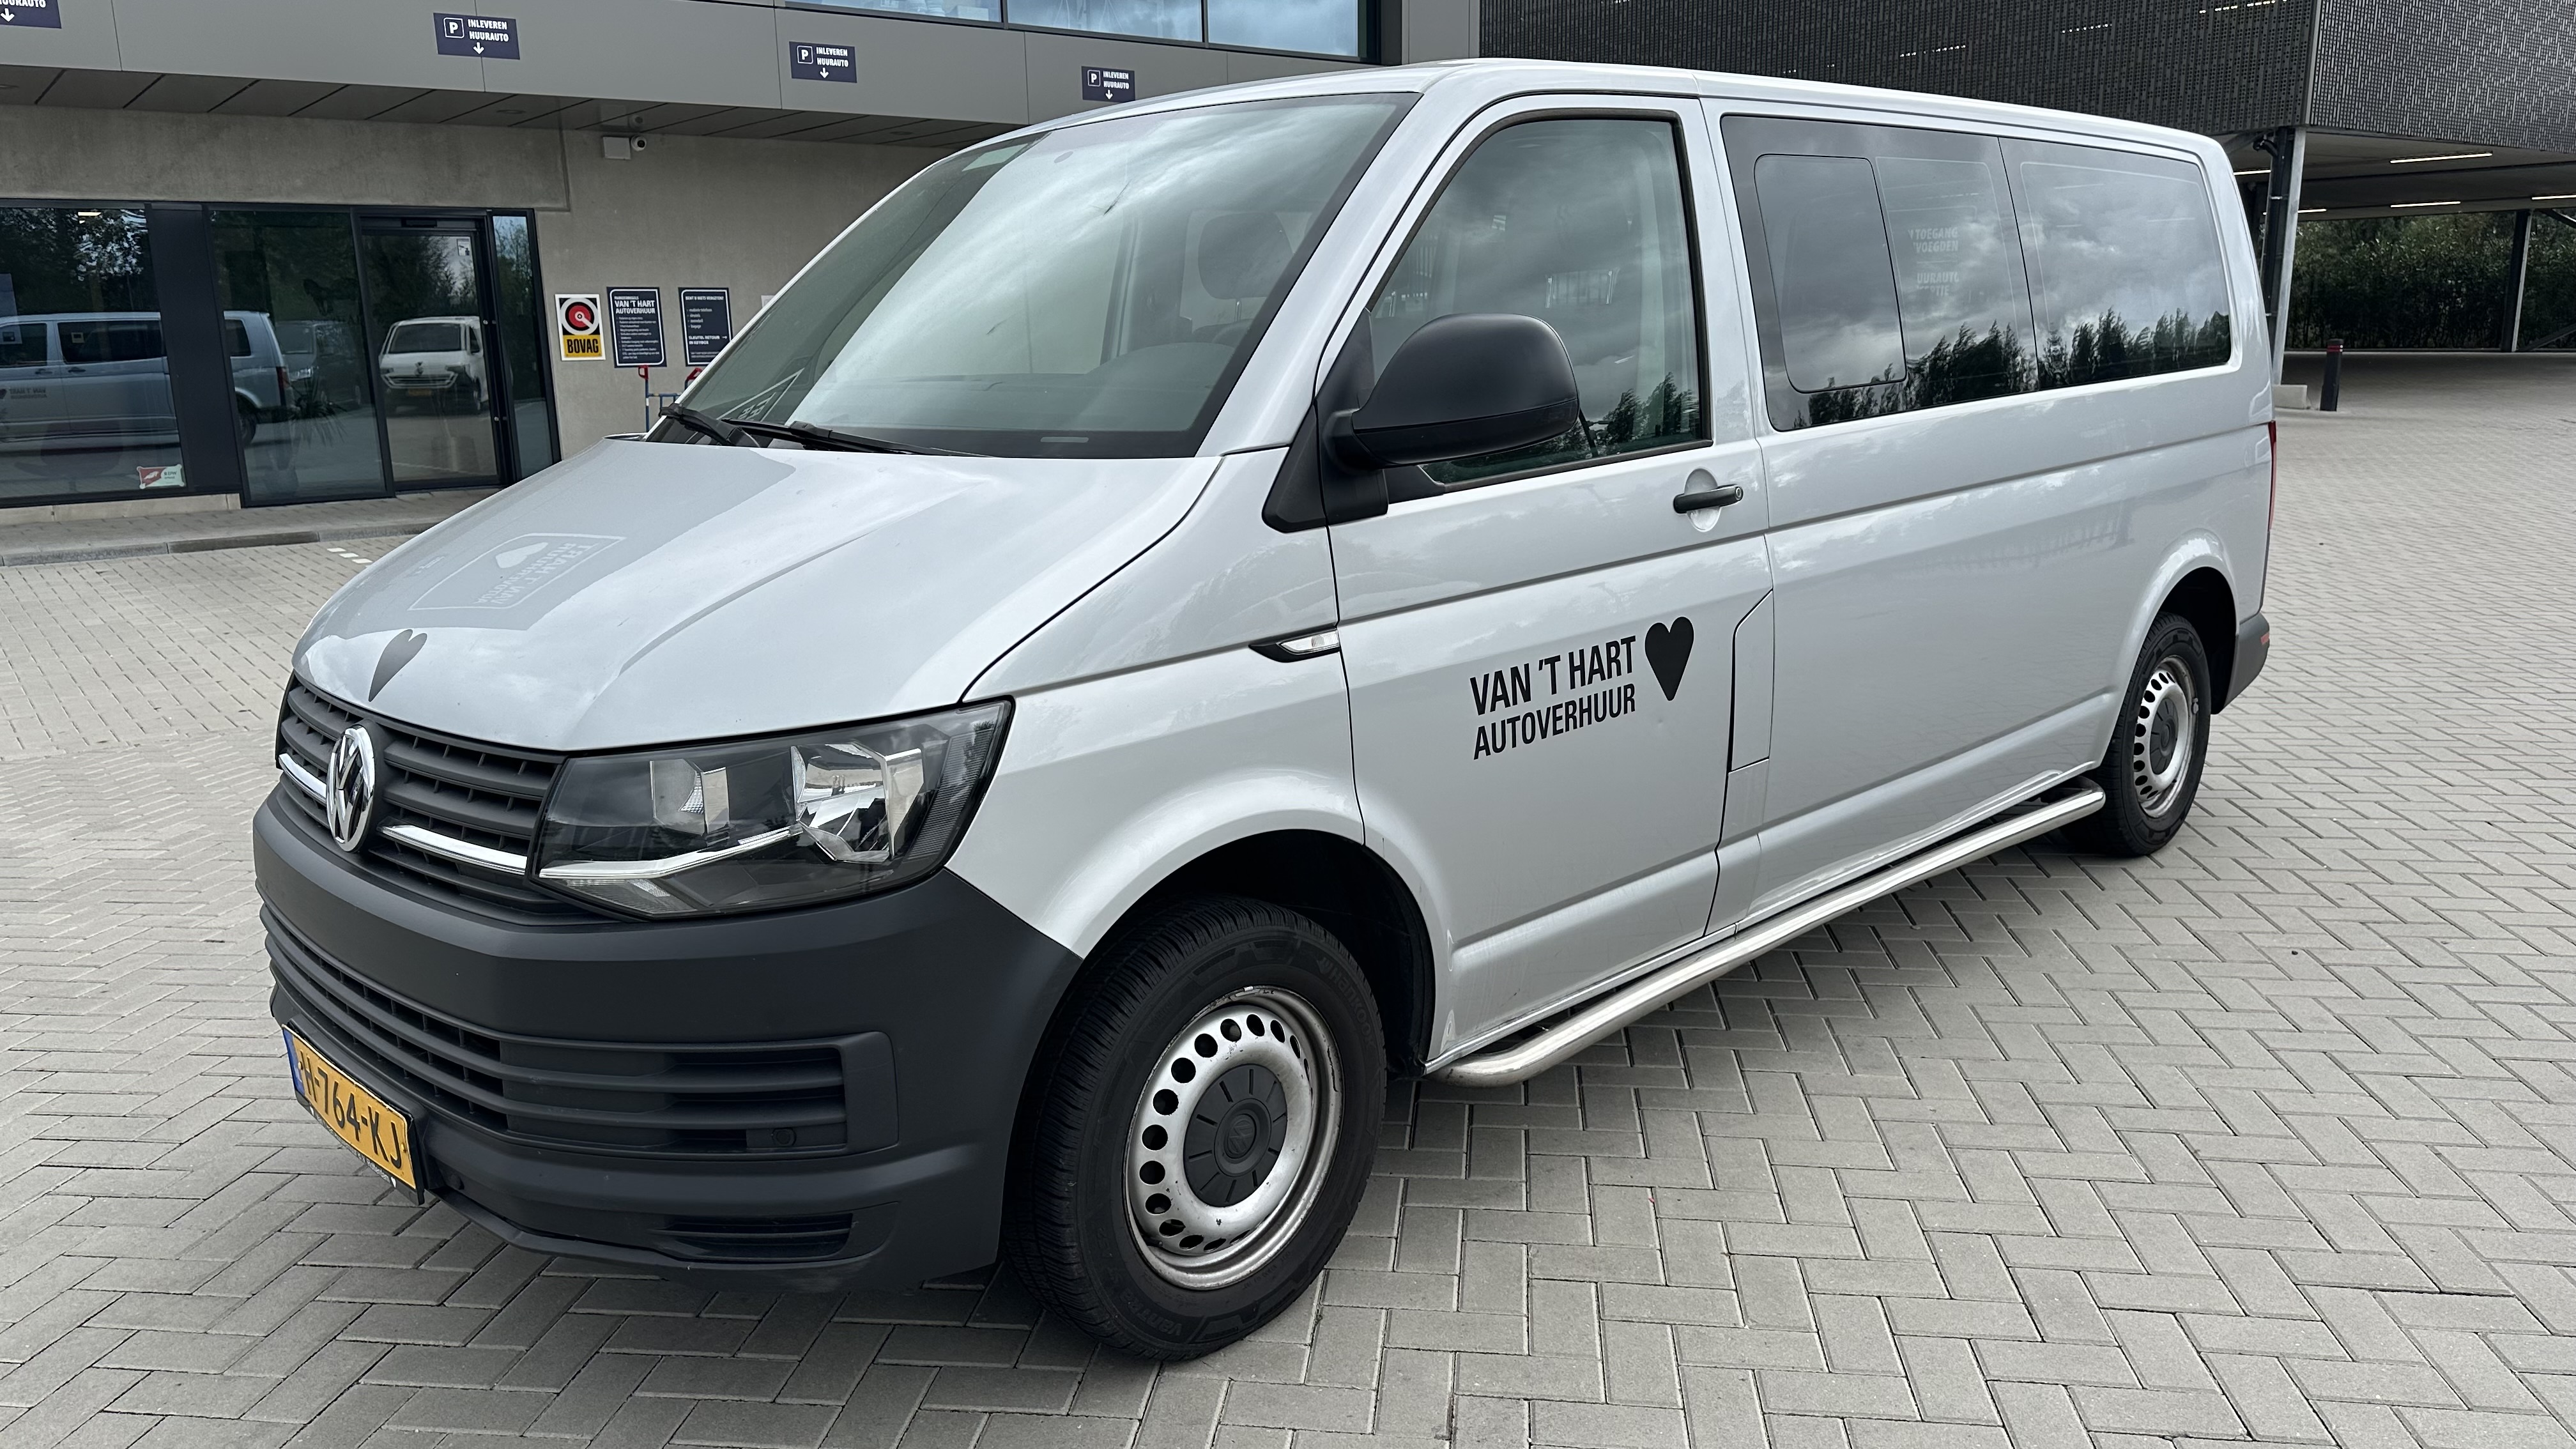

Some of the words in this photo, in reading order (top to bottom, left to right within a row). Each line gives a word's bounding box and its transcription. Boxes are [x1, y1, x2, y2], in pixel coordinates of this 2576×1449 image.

[449, 22, 458, 34] P
[468, 19, 507, 30] INLEVEREN
[469, 31, 509, 42] HUURAUTO
[801, 49, 809, 60] P
[816, 47, 848, 56] INLEVEREN
[816, 57, 848, 67] HUURAUTO
[1091, 73, 1098, 83] P
[1103, 71, 1129, 80] INLEVEREN
[1103, 80, 1130, 89] HUURAUTO
[567, 339, 599, 353] BOVAG
[1470, 663, 1531, 716] VAN
[1538, 654, 1561, 695] 'T
[1568, 635, 1636, 690] HART
[1473, 683, 1636, 760] AUTOVERHUUR
[299, 1050, 402, 1169] H-764-KJ
